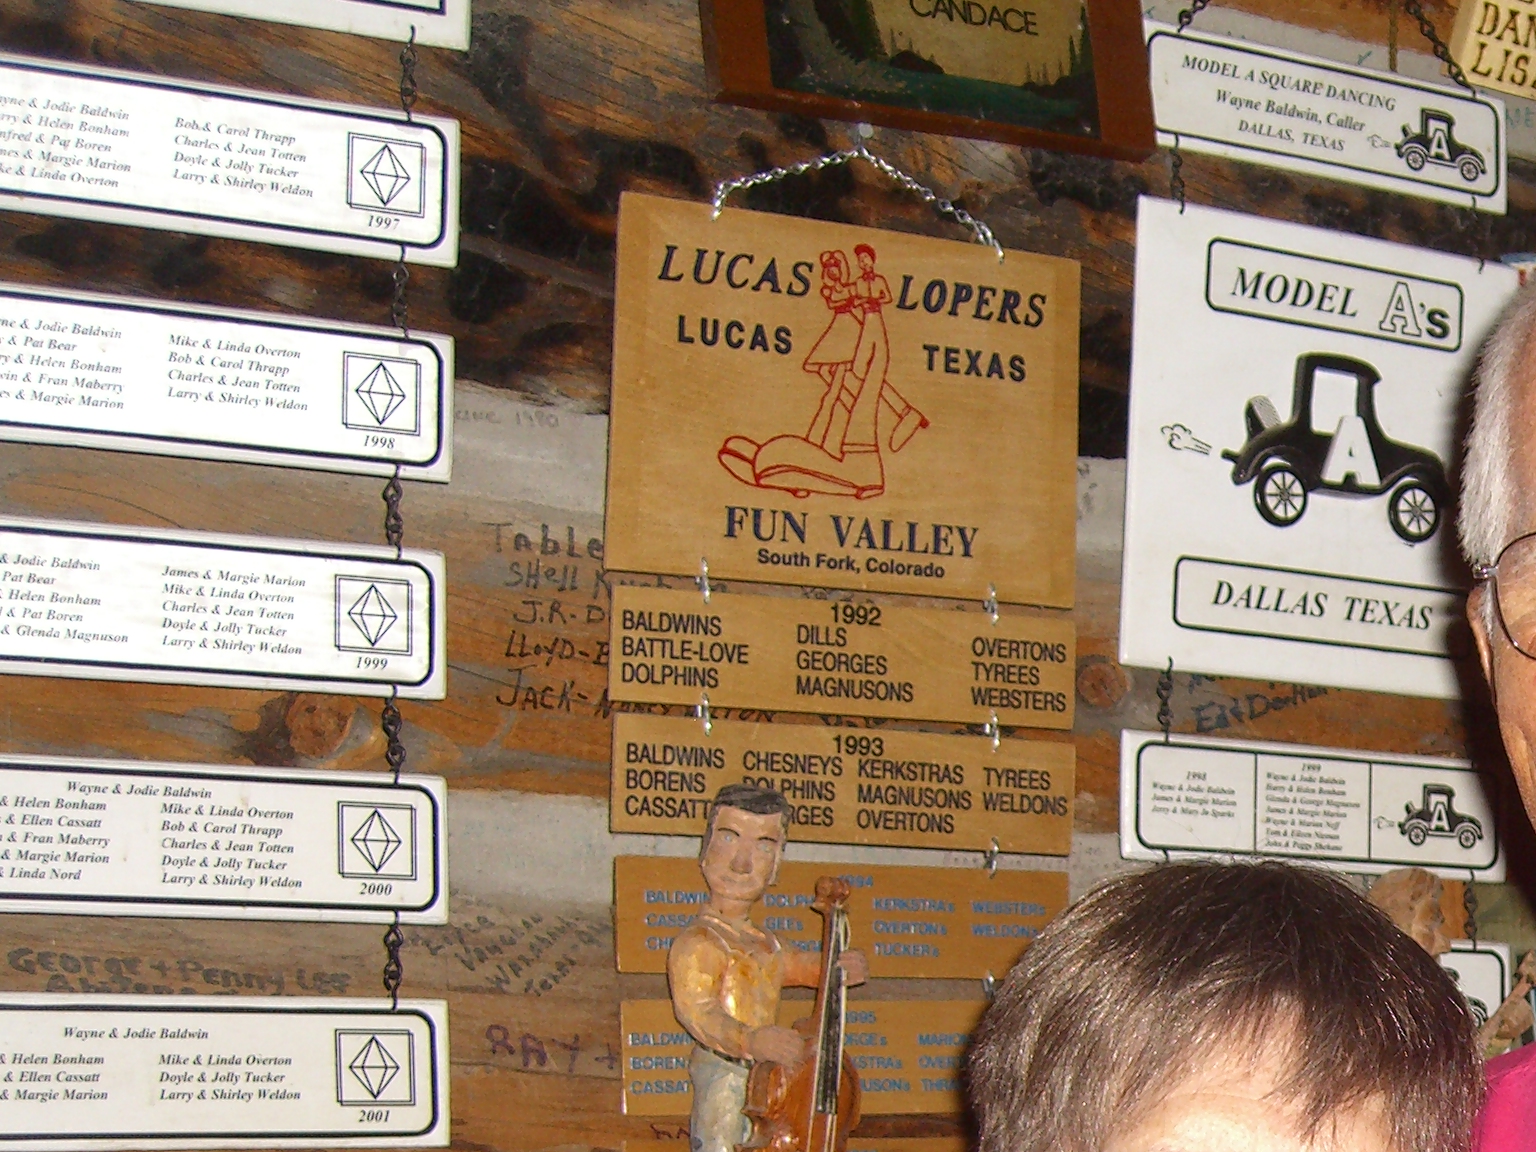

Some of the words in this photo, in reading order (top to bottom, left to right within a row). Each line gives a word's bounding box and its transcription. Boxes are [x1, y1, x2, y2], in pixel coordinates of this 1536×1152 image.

[909, 0, 1039, 36] CANDACE
[1181, 54, 1240, 79] MODEL
[1244, 69, 1255, 82] A
[1258, 70, 1324, 96] SQUARE
[1325, 84, 1396, 112] DANCING
[1216, 88, 1262, 111] Wayne
[1264, 99, 1322, 125] Baldwin,
[1325, 112, 1366, 132] Caller
[1238, 119, 1295, 142] DALLAS,
[1302, 132, 1345, 152] TEXAS
[368, 214, 401, 229] 1997
[657, 244, 814, 298] LUCAS
[895, 274, 1047, 329] LOPERS
[1227, 267, 1357, 321] MODEL
[677, 314, 792, 356] LUCAS
[922, 343, 1026, 383] TEXAS
[364, 435, 396, 449] 1998
[723, 505, 809, 544] FUN
[829, 514, 979, 559] VALLEY
[161, 565, 199, 579] James
[202, 569, 212, 580] &
[219, 569, 261, 585] Margie
[265, 573, 306, 587] Marion
[757, 548, 811, 568] South
[815, 552, 861, 575] Fork,
[865, 557, 946, 579] Colorado
[830, 601, 882, 627] 1992
[1212, 580, 1328, 618] DALLAS
[1345, 596, 1435, 630] TEXAS
[622, 609, 722, 637] BALDWINS
[796, 624, 847, 648] DILLS
[356, 656, 388, 670] 1999
[621, 636, 749, 665] BATTLE-LOVE
[796, 650, 888, 676] GEORGES
[971, 637, 1067, 664] OVERTONS
[621, 662, 719, 689] DOLPHINS
[971, 661, 1041, 686] TYREES
[795, 676, 914, 703] MAGNUSONS
[971, 686, 1067, 713] WEBSTERS
[626, 742, 725, 769] BALDWINS
[832, 734, 885, 758] 1993
[742, 750, 843, 777] CHESNEYS
[857, 758, 965, 785] KERKSTRAS
[626, 769, 706, 794] BORENS
[983, 766, 1051, 791] TYREES
[857, 783, 972, 812] MAGNUSONS
[982, 791, 1068, 817] WELDONS
[160, 802, 189, 815] Mike
[194, 804, 204, 816] &
[209, 804, 244, 817] Linda
[247, 807, 294, 820] Overton
[856, 808, 955, 835] OVERTONS
[160, 820, 185, 832] Bob
[188, 821, 198, 833] &
[203, 821, 238, 835] Carol
[241, 823, 283, 839] Thrapp
[359, 882, 393, 896] 2000
[64, 1026, 106, 1042] Wayne
[108, 1027, 118, 1039] &
[122, 1027, 157, 1039] Jodie
[159, 1027, 209, 1040] Baldwin
[158, 1054, 190, 1065] Mike
[192, 1054, 203, 1066] &
[207, 1054, 242, 1066] Linda
[245, 1054, 292, 1066] Overton
[159, 1071, 194, 1086] Doyle
[196, 1071, 207, 1083] &
[211, 1071, 241, 1086] Jolly
[244, 1071, 286, 1083] Tucker
[14, 1088, 60, 1103] Margie
[62, 1088, 108, 1101] Marion
[159, 1088, 194, 1103] Larry
[196, 1089, 207, 1100] &
[210, 1088, 254, 1103] Shirley
[258, 1088, 301, 1100] Weldon
[358, 1109, 390, 1123] 2001
